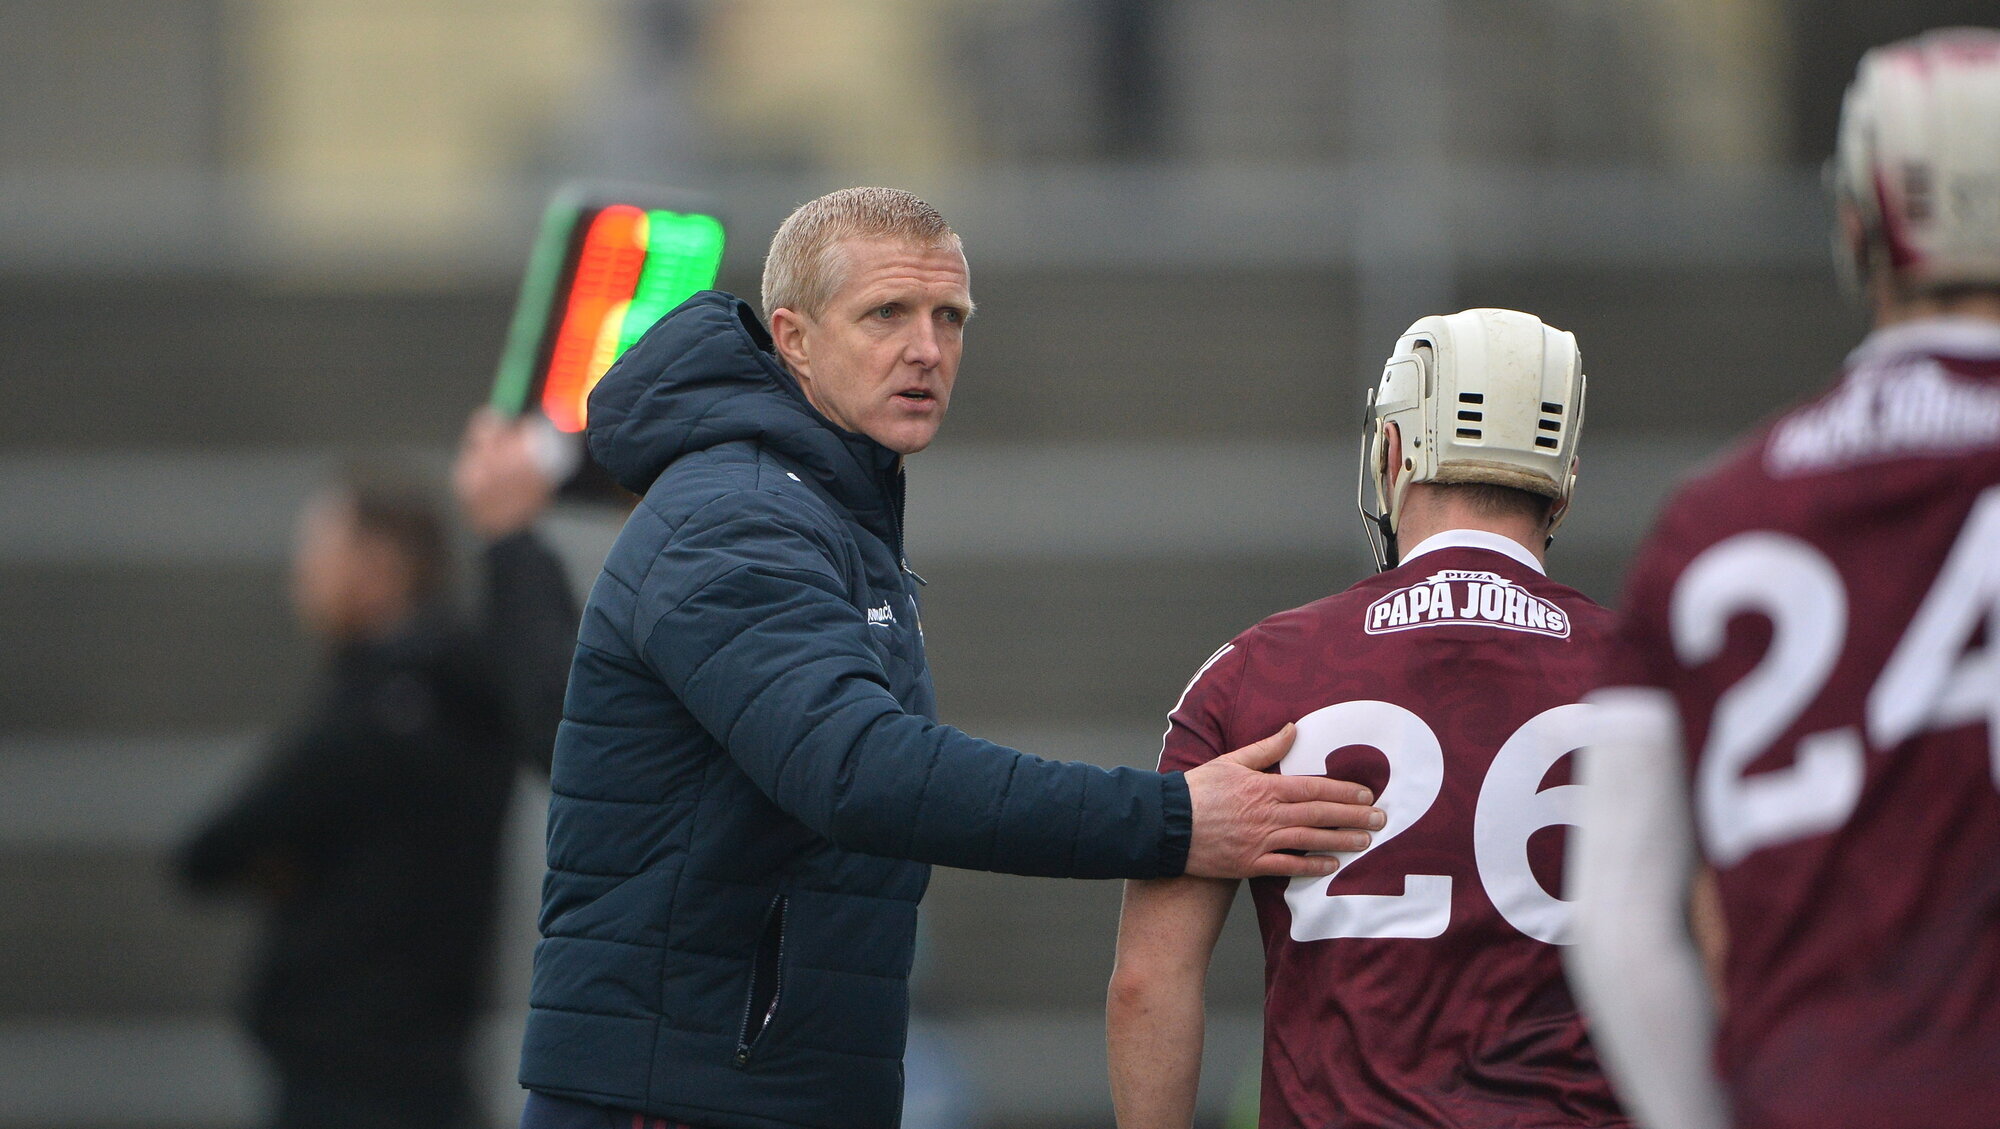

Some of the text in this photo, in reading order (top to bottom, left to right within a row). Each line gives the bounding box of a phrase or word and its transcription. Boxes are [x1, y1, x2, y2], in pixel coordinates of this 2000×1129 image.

[1372, 583, 1454, 629] PAPA
[1444, 572, 1494, 581] PIZZA
[1668, 484, 2000, 869] 24
[1280, 700, 1592, 946] 26
